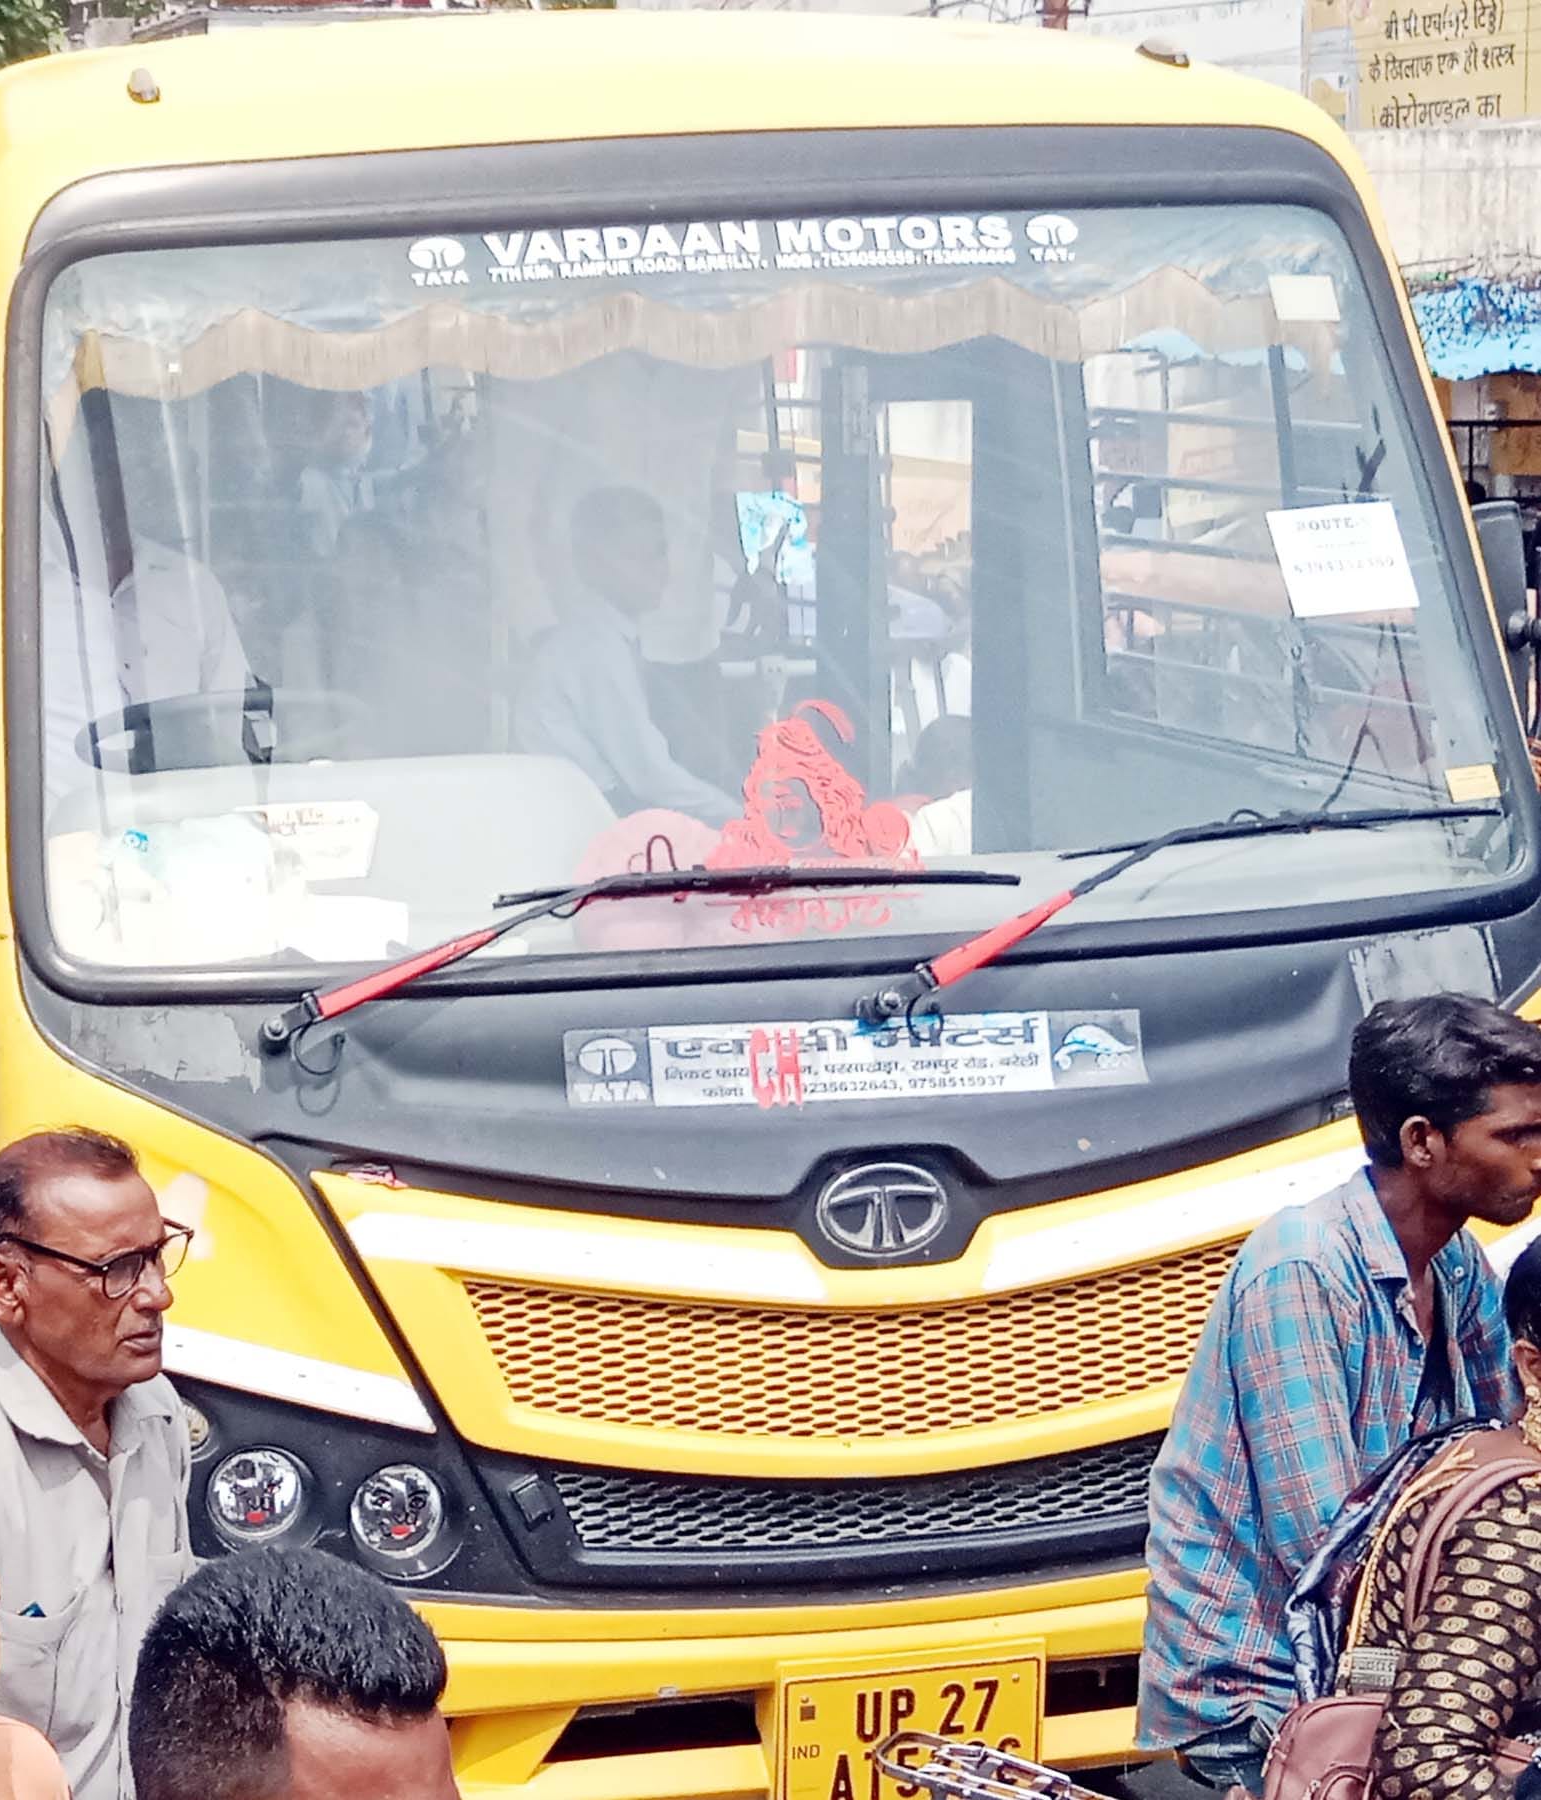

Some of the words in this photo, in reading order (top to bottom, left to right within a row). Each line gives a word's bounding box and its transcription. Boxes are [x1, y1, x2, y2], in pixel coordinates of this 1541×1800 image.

[1476, 93, 1501, 119] का
[482, 219, 761, 266] VARDAAN
[774, 214, 1012, 254] MOTORS
[411, 269, 469, 287] TATA
[559, 257, 629, 279] RAMPUR
[571, 1079, 650, 1103] TATA
[856, 1688, 916, 1743] UP
[940, 1679, 999, 1736] 27
[792, 1744, 820, 1760] IND
